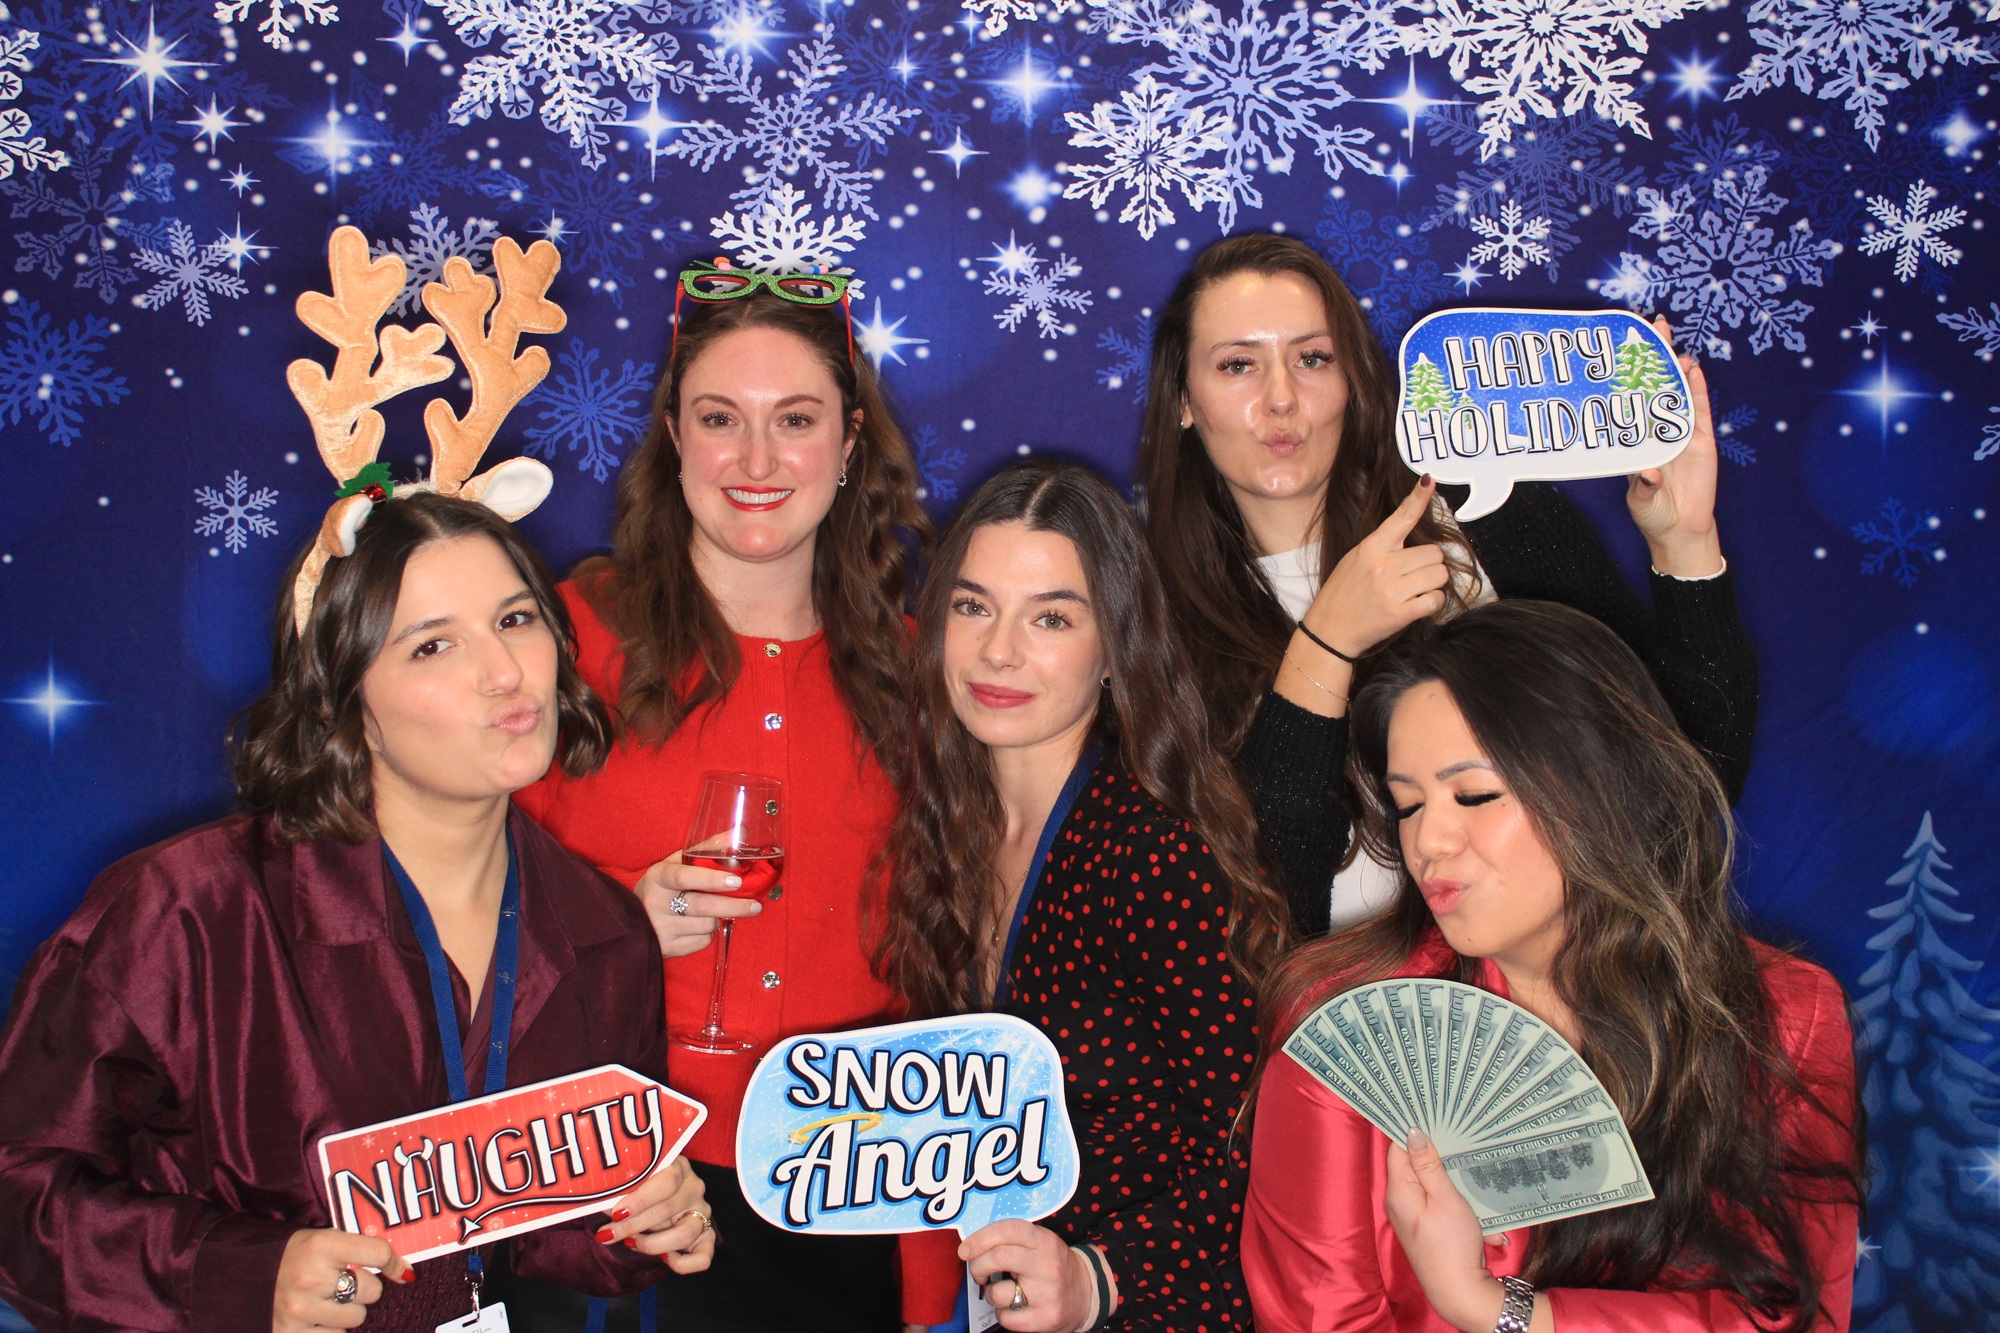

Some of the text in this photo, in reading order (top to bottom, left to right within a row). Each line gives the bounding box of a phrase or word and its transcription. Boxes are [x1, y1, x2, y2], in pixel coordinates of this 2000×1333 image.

[1446, 328, 1614, 391] HAPPY
[1402, 393, 1690, 462] HOLIDAYS
[1376, 1033, 1391, 1053] ONE
[1400, 1027, 1412, 1048] ONE
[1426, 1026, 1435, 1048] ONE
[1451, 1029, 1459, 1050] ONE
[1356, 1043, 1372, 1063] ONE
[1472, 1037, 1483, 1057] ONE
[1338, 1057, 1356, 1075] ONE
[1492, 1050, 1506, 1068] ONE
[788, 1041, 1008, 1117] SNOW
[1512, 1066, 1529, 1083] ONE
[1530, 1085, 1548, 1100] ONE
[1546, 1107, 1565, 1121] ONE
[1514, 1135, 1559, 1152] HUNDRED
[1558, 1130, 1579, 1142] ONE
[772, 1098, 1050, 1226] Angel
[1472, 1145, 1514, 1162] DOLLARS
[332, 1086, 664, 1240] NAUGHTY
[1567, 1194, 1602, 1208] UNITED
[1601, 1190, 1621, 1201] THE
[1522, 1208, 1535, 1218] OF
[1533, 1201, 1569, 1216] STATES
[1480, 1211, 1523, 1227] AMERICA
